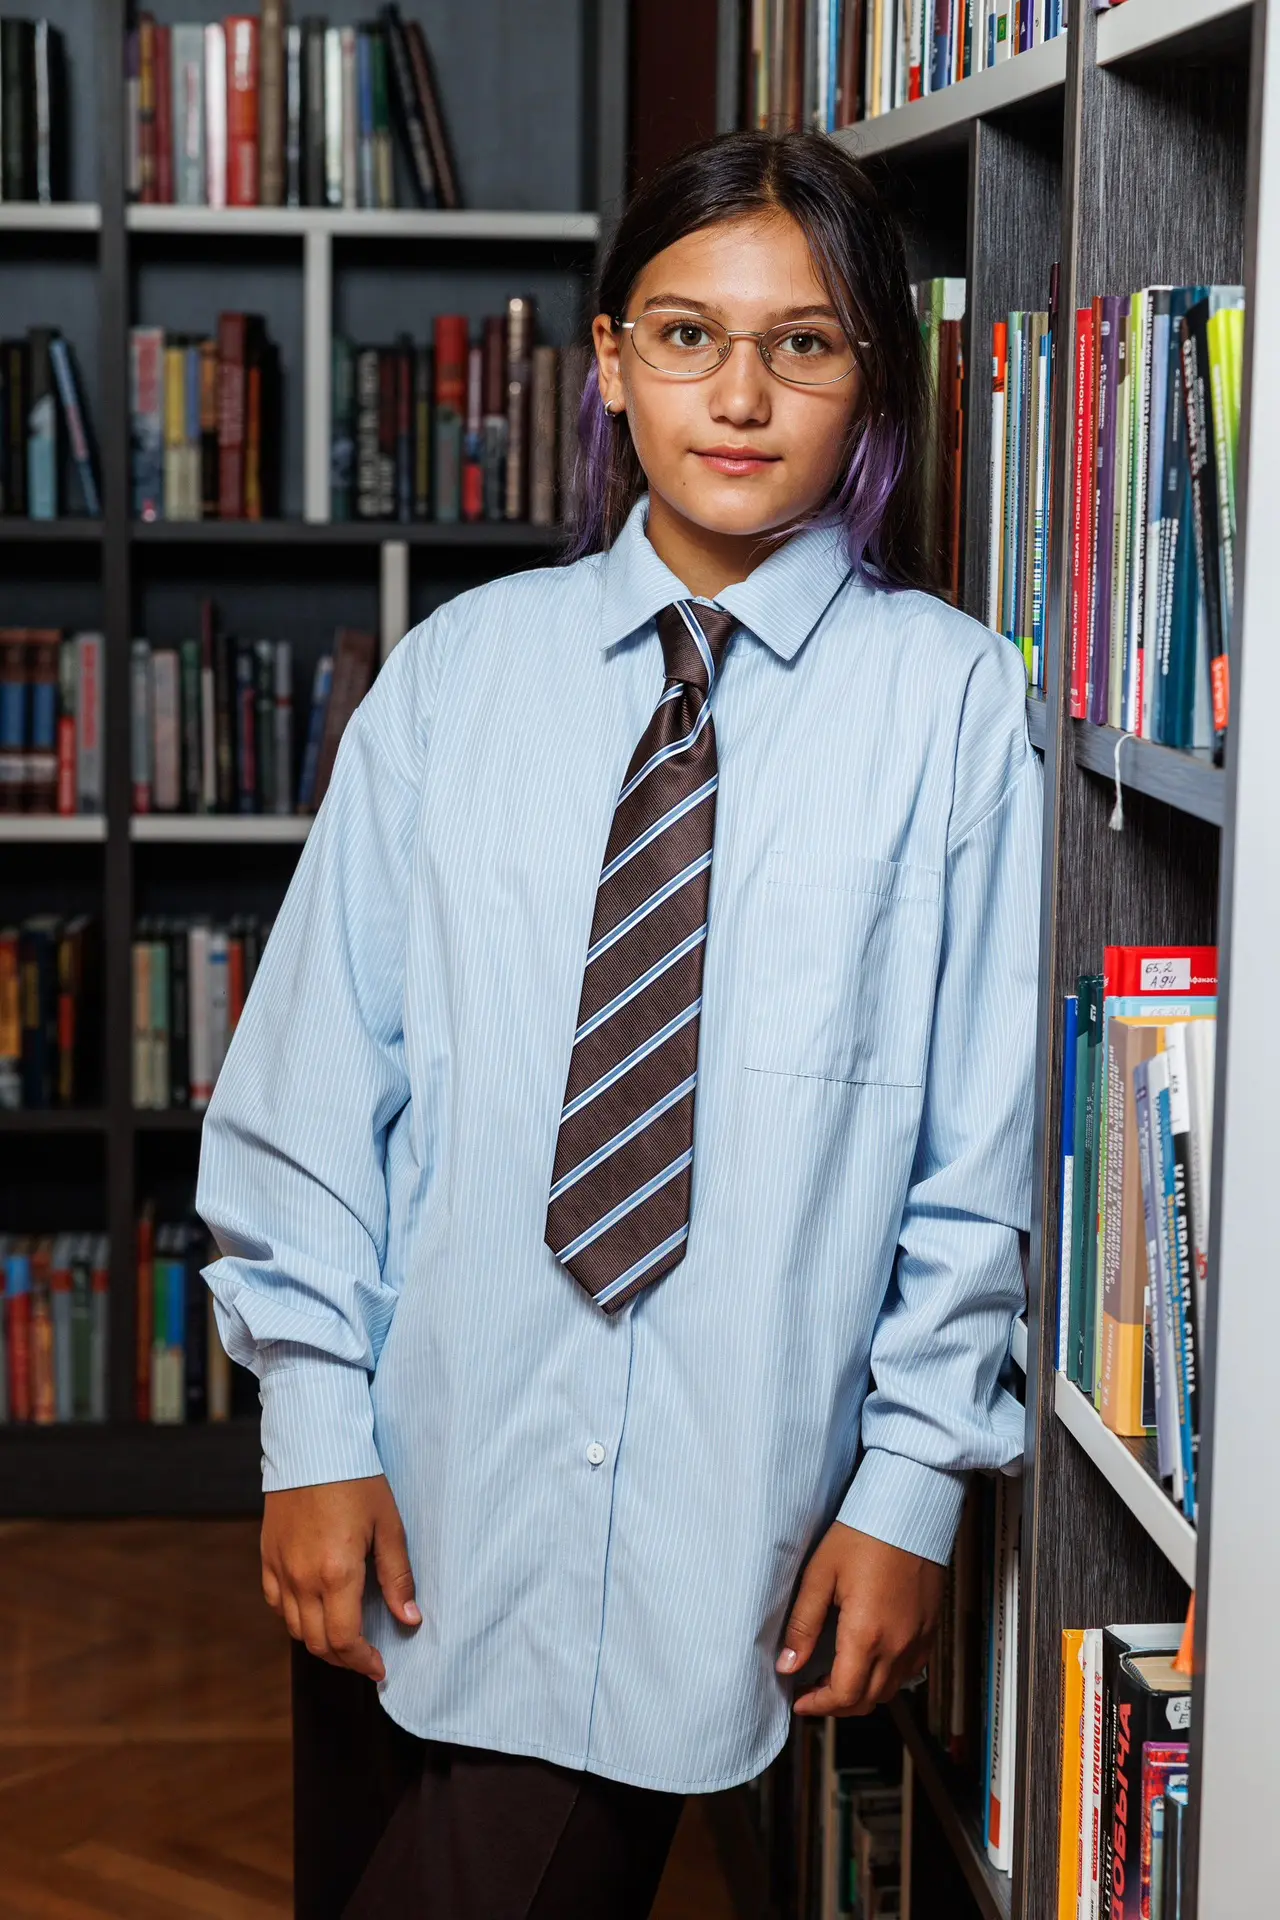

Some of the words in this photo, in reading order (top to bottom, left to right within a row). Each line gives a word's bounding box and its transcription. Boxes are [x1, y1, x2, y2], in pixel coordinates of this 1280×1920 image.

[1162, 518, 1178, 675] Международные
[1117, 1080, 1125, 1128] СФЕРЫ
[1105, 1206, 1113, 1293] АКТУАЛЬНЫЕ
[1109, 1205, 1118, 1284] ЭКОНОМИКИ
[1114, 1132, 1123, 1269] ПРОИЗВОДСТВЕННОЙ
[1176, 1214, 1192, 1315] ПРОДАТЬ
[1183, 1322, 1196, 1396] СЛОНА
[991, 1648, 1002, 1780] Управление
[1092, 1691, 1101, 1795] АВТОМОЙКА
